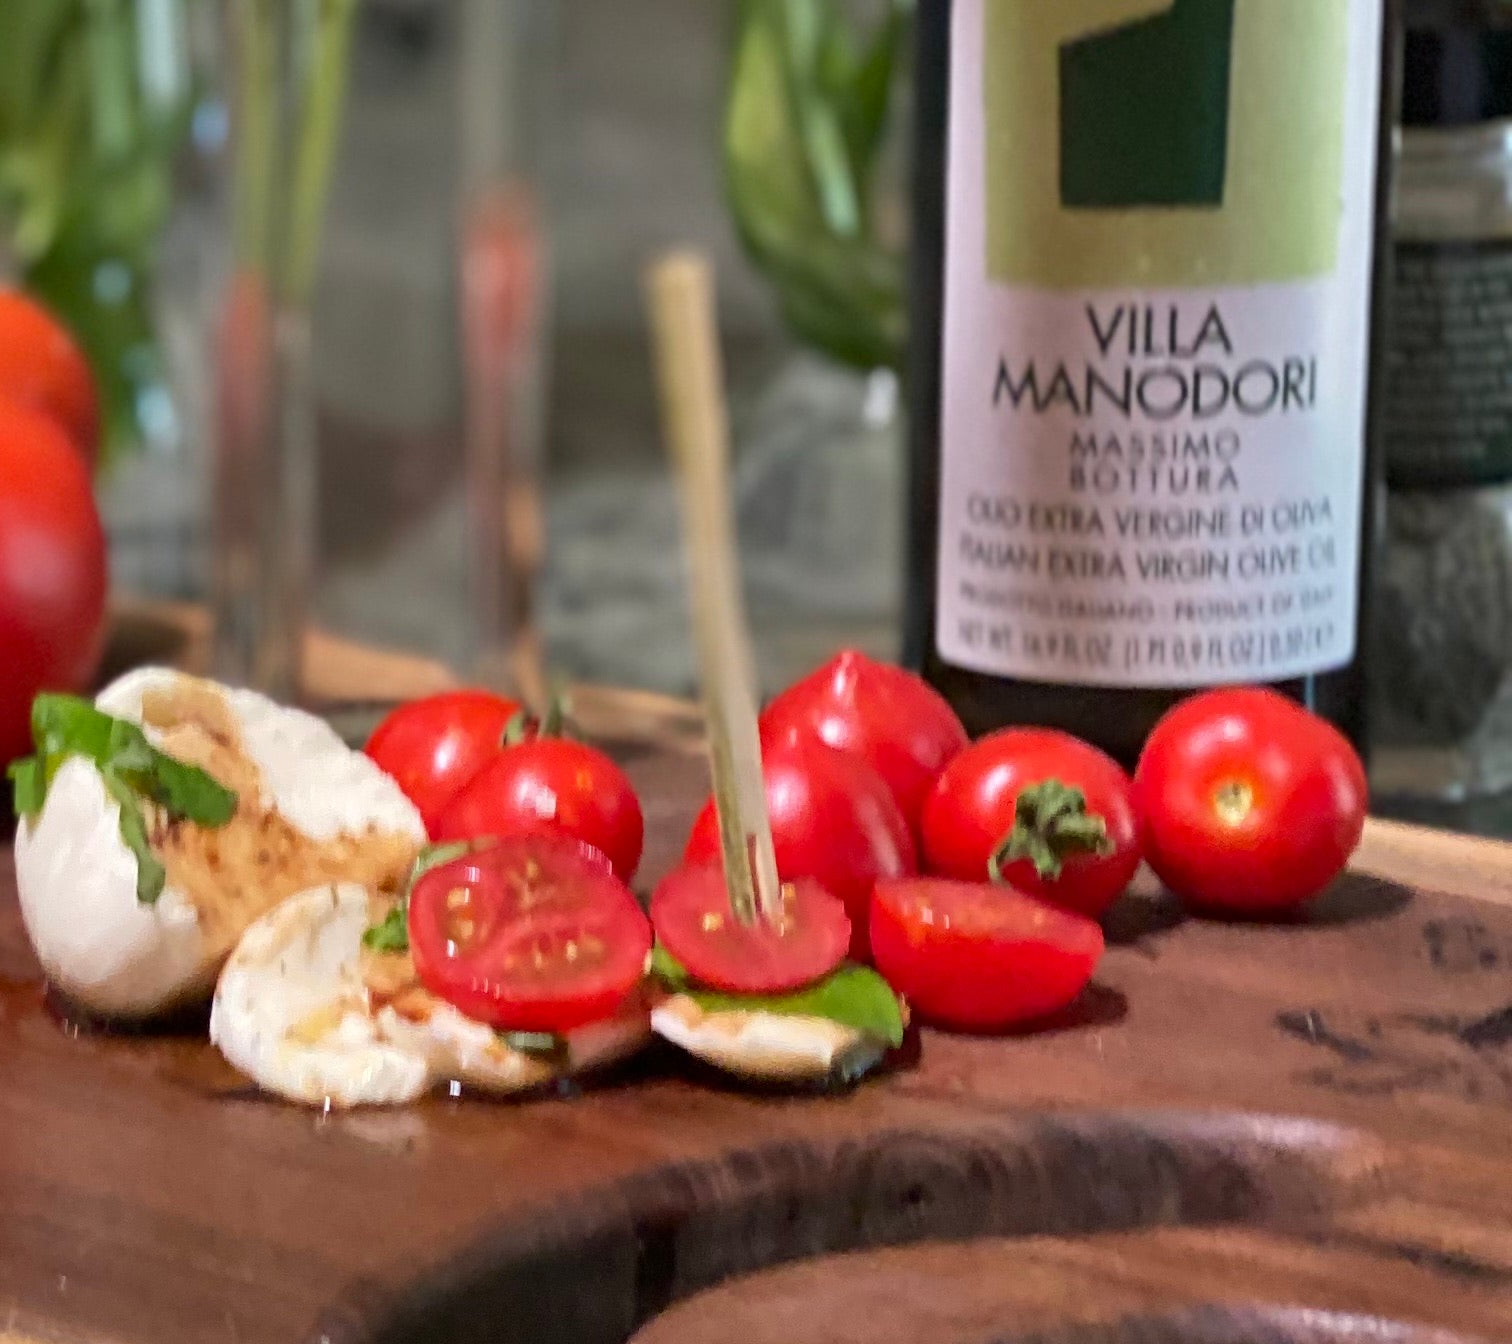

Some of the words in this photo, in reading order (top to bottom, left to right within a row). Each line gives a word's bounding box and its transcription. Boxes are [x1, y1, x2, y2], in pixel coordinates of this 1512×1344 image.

[1085, 303, 1234, 358] VILLA
[992, 356, 1317, 420] MANODORI
[1070, 426, 1241, 462] MASSIMO
[1070, 462, 1240, 496] BOTTURA
[1115, 504, 1230, 541] VERGINE
[1241, 504, 1264, 536] DI
[1272, 496, 1333, 533] OLIVA
[1136, 546, 1229, 586] VIRGIN
[1238, 544, 1299, 582] OLIVE
